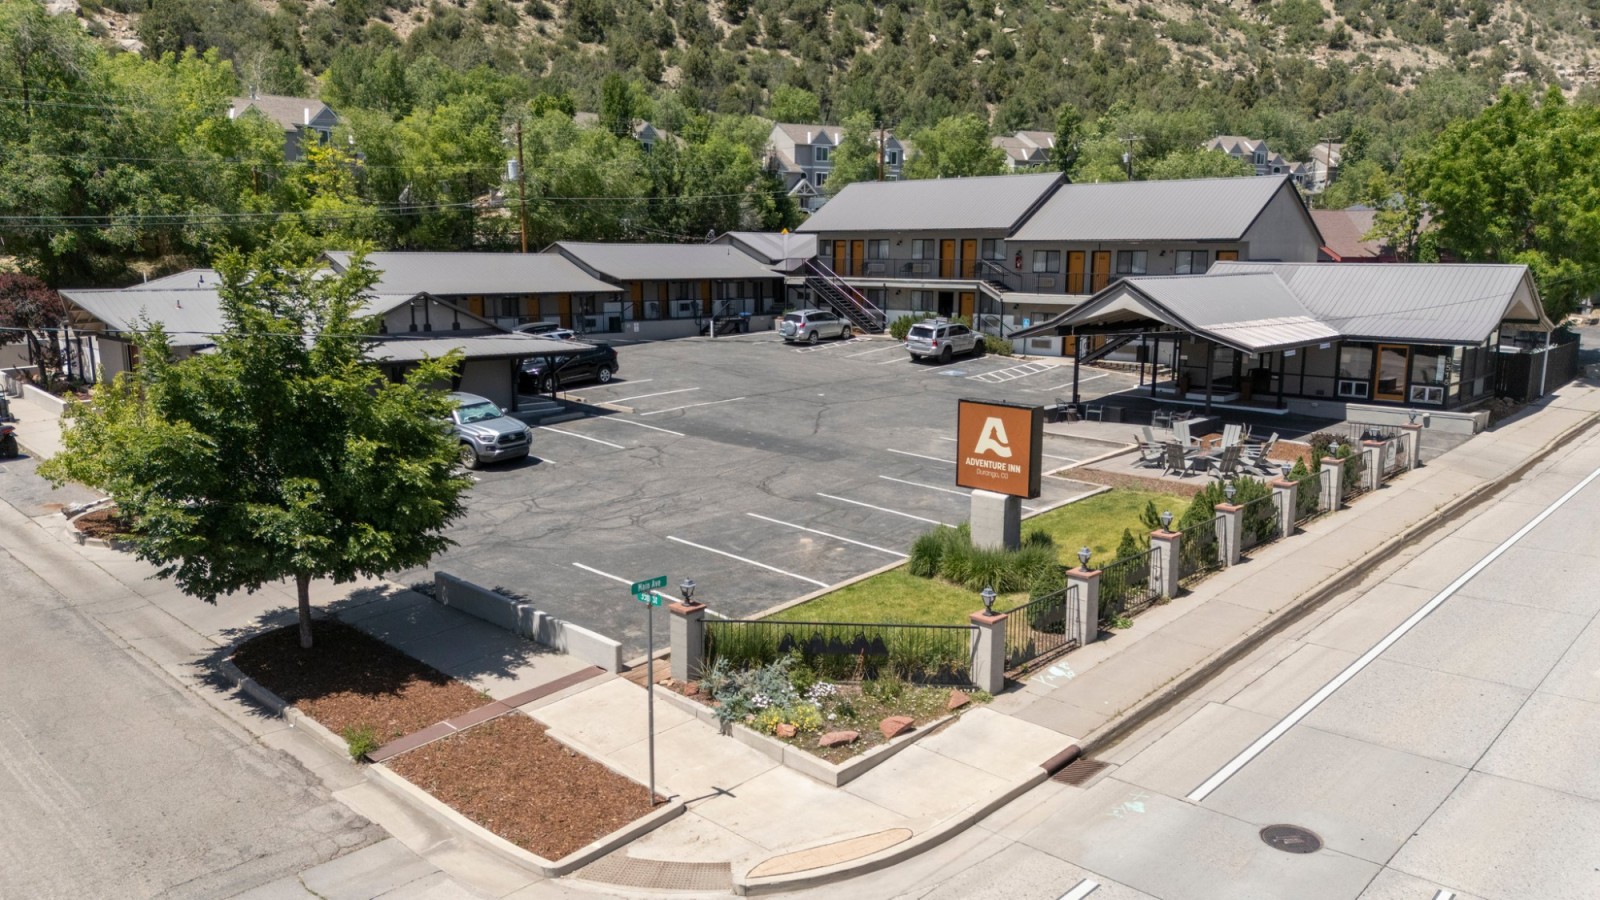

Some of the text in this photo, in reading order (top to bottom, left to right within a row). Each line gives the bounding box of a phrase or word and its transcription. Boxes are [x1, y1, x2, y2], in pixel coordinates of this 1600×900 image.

[974, 416, 1012, 458] A
[965, 457, 1021, 474] ADVENTURE INN
[976, 468, 1009, 480] Durango, CO
[637, 579, 661, 592] Main Ave
